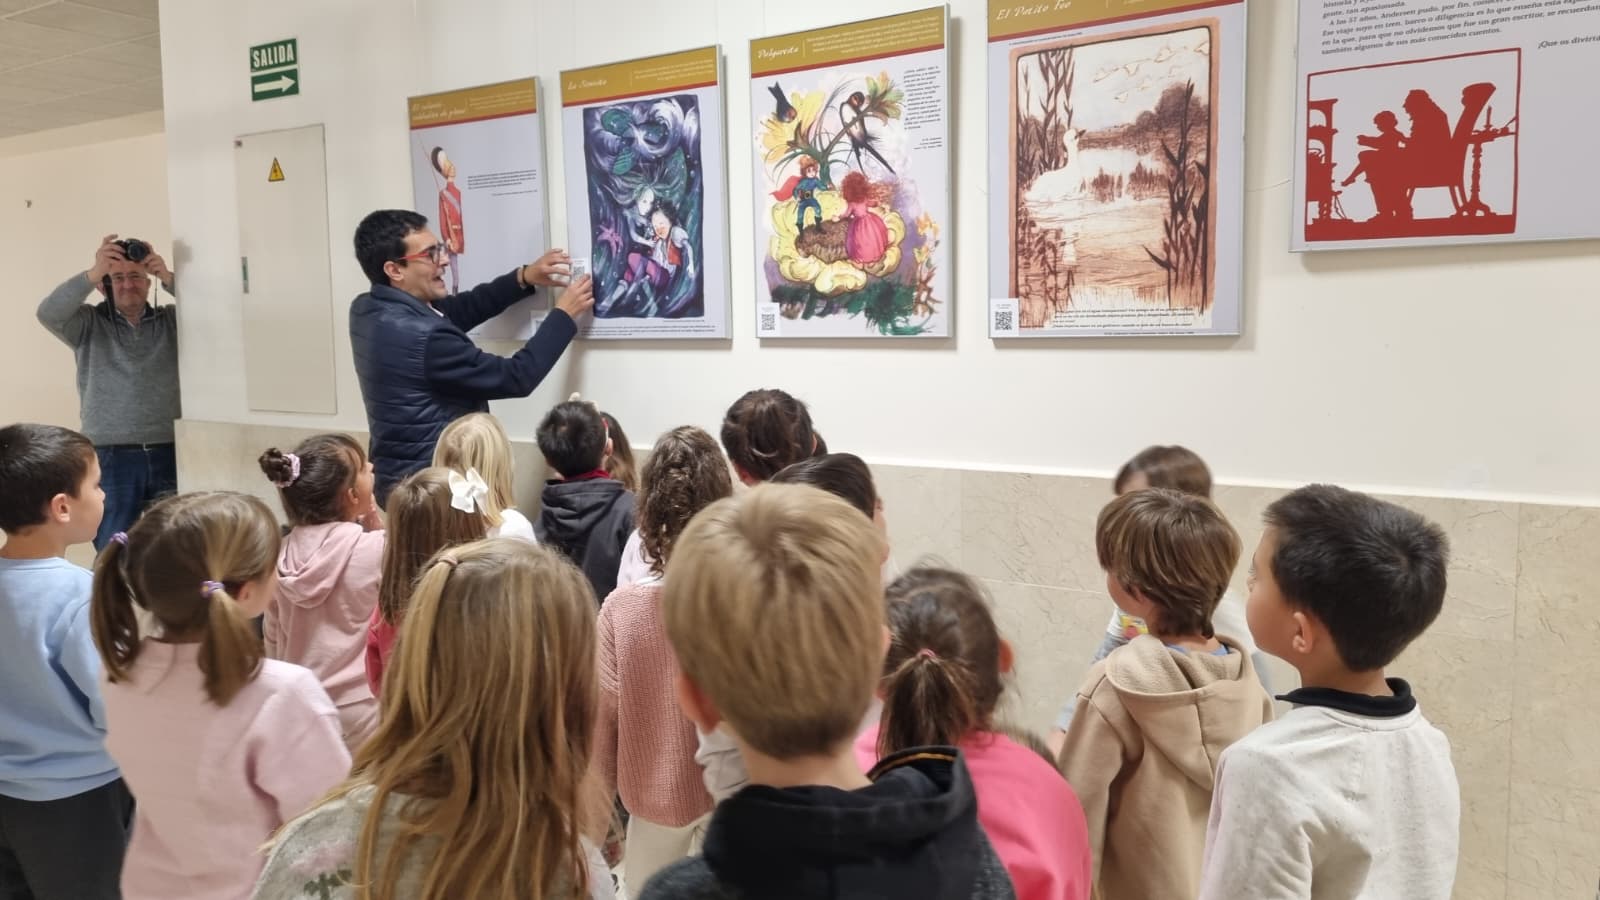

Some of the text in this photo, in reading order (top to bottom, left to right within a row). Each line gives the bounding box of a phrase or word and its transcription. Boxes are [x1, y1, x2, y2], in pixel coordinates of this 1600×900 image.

[997, 0, 1072, 20] El Patito Feo
[1336, 27, 1354, 35] viaje
[1404, 18, 1427, 26] barco
[1434, 11, 1475, 21] diligencia
[1496, 6, 1512, 14] que
[1513, 1, 1543, 10] enseña
[1381, 9, 1416, 18] Andersen
[1441, 4, 1456, 12] por
[1358, 34, 1377, 43] para
[1377, 32, 1392, 40] que
[1405, 26, 1446, 35] olvidemos
[1446, 23, 1462, 32] que
[1490, 16, 1511, 25] gran
[1354, 43, 1384, 51] algunos
[1427, 32, 1467, 42] conocidos
[253, 43, 294, 68] SALIDA
